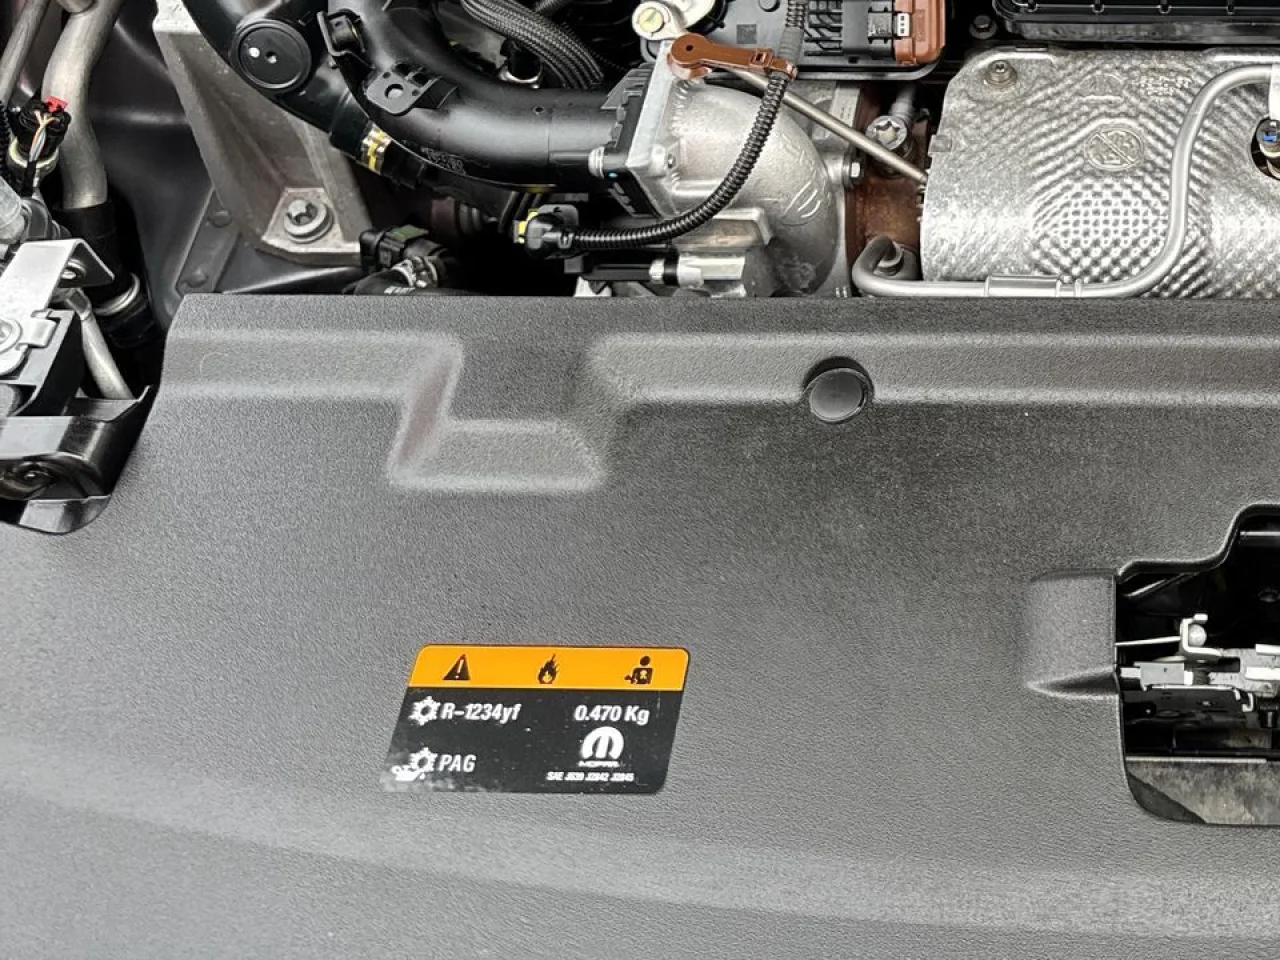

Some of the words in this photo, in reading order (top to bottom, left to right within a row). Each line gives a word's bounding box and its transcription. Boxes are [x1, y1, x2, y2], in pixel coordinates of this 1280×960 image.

[440, 703, 522, 724] R-1234yf
[574, 704, 622, 722] 0.470
[624, 705, 650, 725] Kg
[439, 754, 477, 773] PAG
